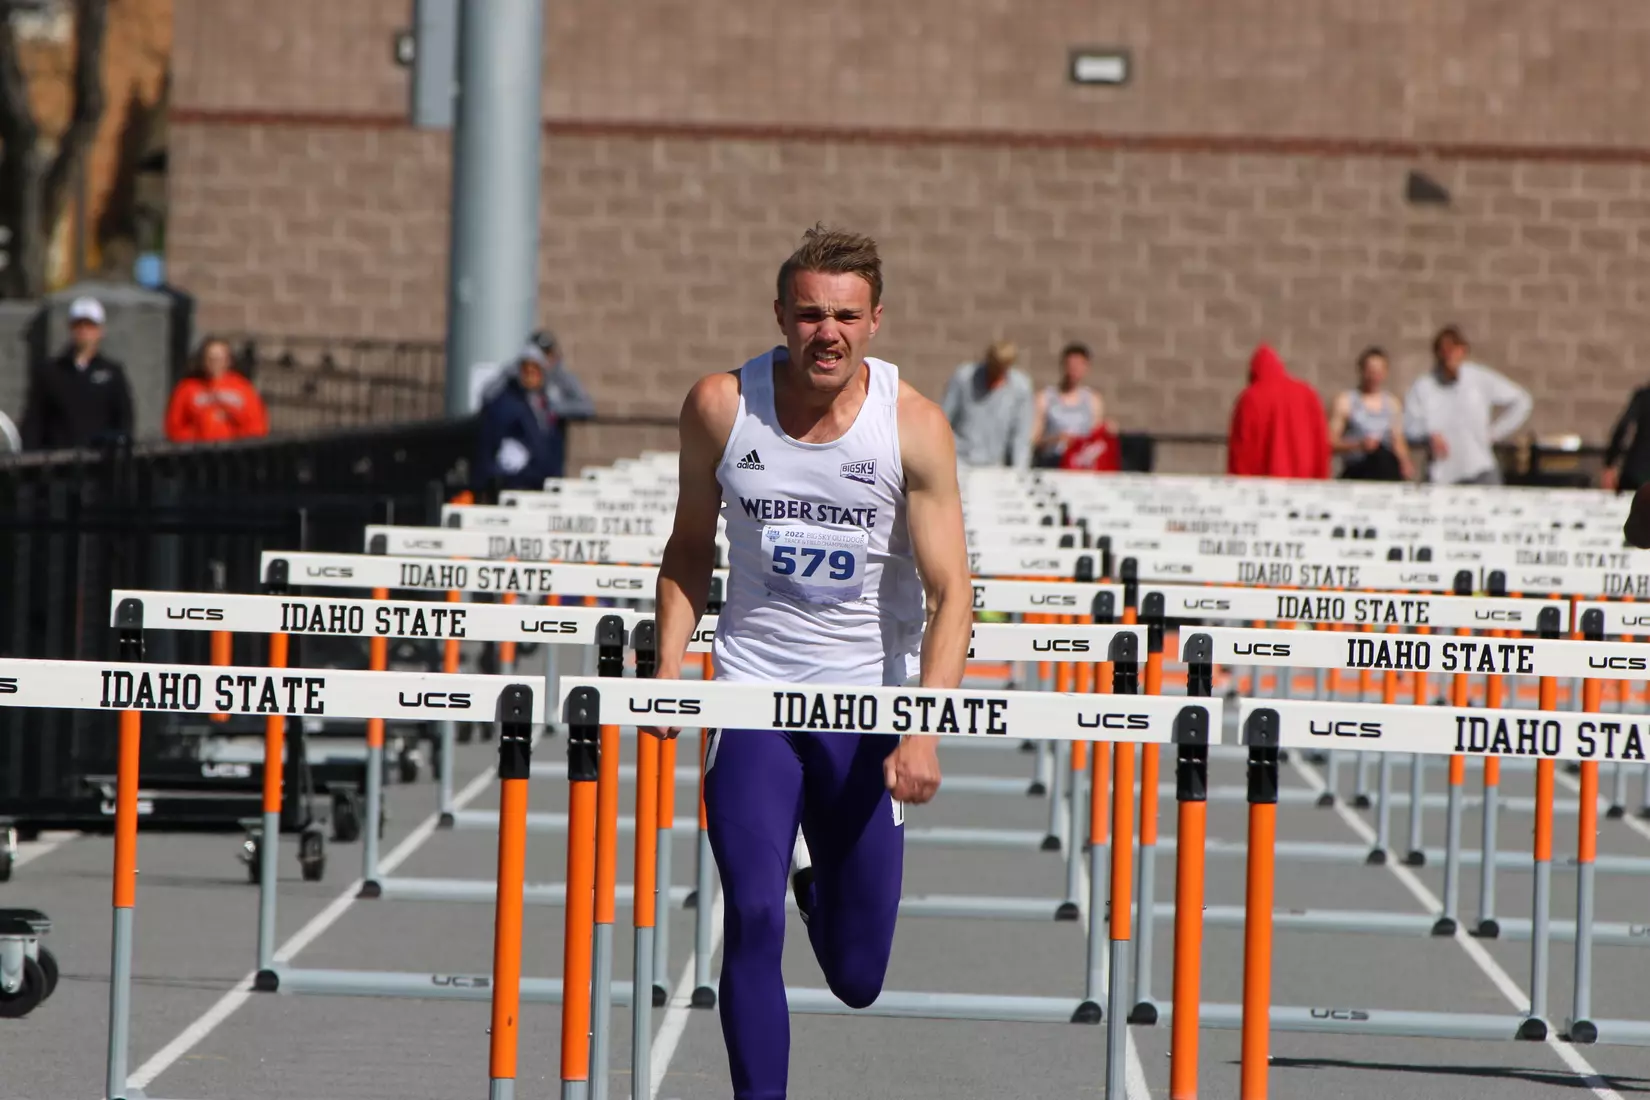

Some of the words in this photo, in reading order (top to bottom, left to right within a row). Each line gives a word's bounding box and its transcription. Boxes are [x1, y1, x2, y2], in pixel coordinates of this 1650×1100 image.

[737, 461, 765, 471] adidas
[739, 497, 812, 520] WEBER
[817, 504, 878, 528] STATE
[784, 530, 805, 538] 2022
[832, 534, 864, 544] OUTDOOR
[487, 536, 543, 560] IDAHO
[548, 539, 611, 562] STATE
[772, 545, 855, 580] 579
[1154, 563, 1194, 574] UCS
[306, 566, 354, 579] UCS
[400, 563, 468, 589] IDAHO
[478, 567, 552, 592] STATE
[1237, 562, 1293, 583] IDAHO
[1299, 565, 1360, 587] STATE
[1399, 573, 1440, 584] UCS
[596, 578, 644, 590] UCS
[1522, 575, 1563, 587] UCS
[1603, 573, 1650, 597] IDAH
[1030, 594, 1077, 607] UCS
[1183, 598, 1231, 611] UCS
[166, 607, 224, 621] UCS
[1276, 596, 1345, 621] IDAHO
[1355, 599, 1430, 625] STATE
[1475, 610, 1522, 622] UCS
[280, 602, 364, 634] IDAHO
[374, 606, 466, 638] STATE
[520, 620, 578, 634] UCS
[1622, 615, 1650, 627] UC
[691, 630, 715, 643] UC
[1032, 639, 1090, 653] UCS
[1233, 643, 1291, 657] UCS
[1346, 638, 1431, 670] IDAHO
[1442, 642, 1534, 674] STATE
[1588, 655, 1647, 670] UCS
[100, 670, 202, 711] IDAHO
[215, 674, 326, 715] STATE
[398, 691, 472, 709] UCS
[629, 697, 702, 715] UCS
[773, 691, 878, 731] IDAHO
[893, 695, 1008, 736] STATE
[1077, 712, 1150, 730] UCS
[1309, 720, 1382, 739] UCS
[1455, 715, 1562, 756] IDAHO
[1577, 721, 1650, 760] STA
[100, 799, 155, 815] US
[431, 974, 490, 988] UCS
[1310, 1008, 1370, 1021] UCS
